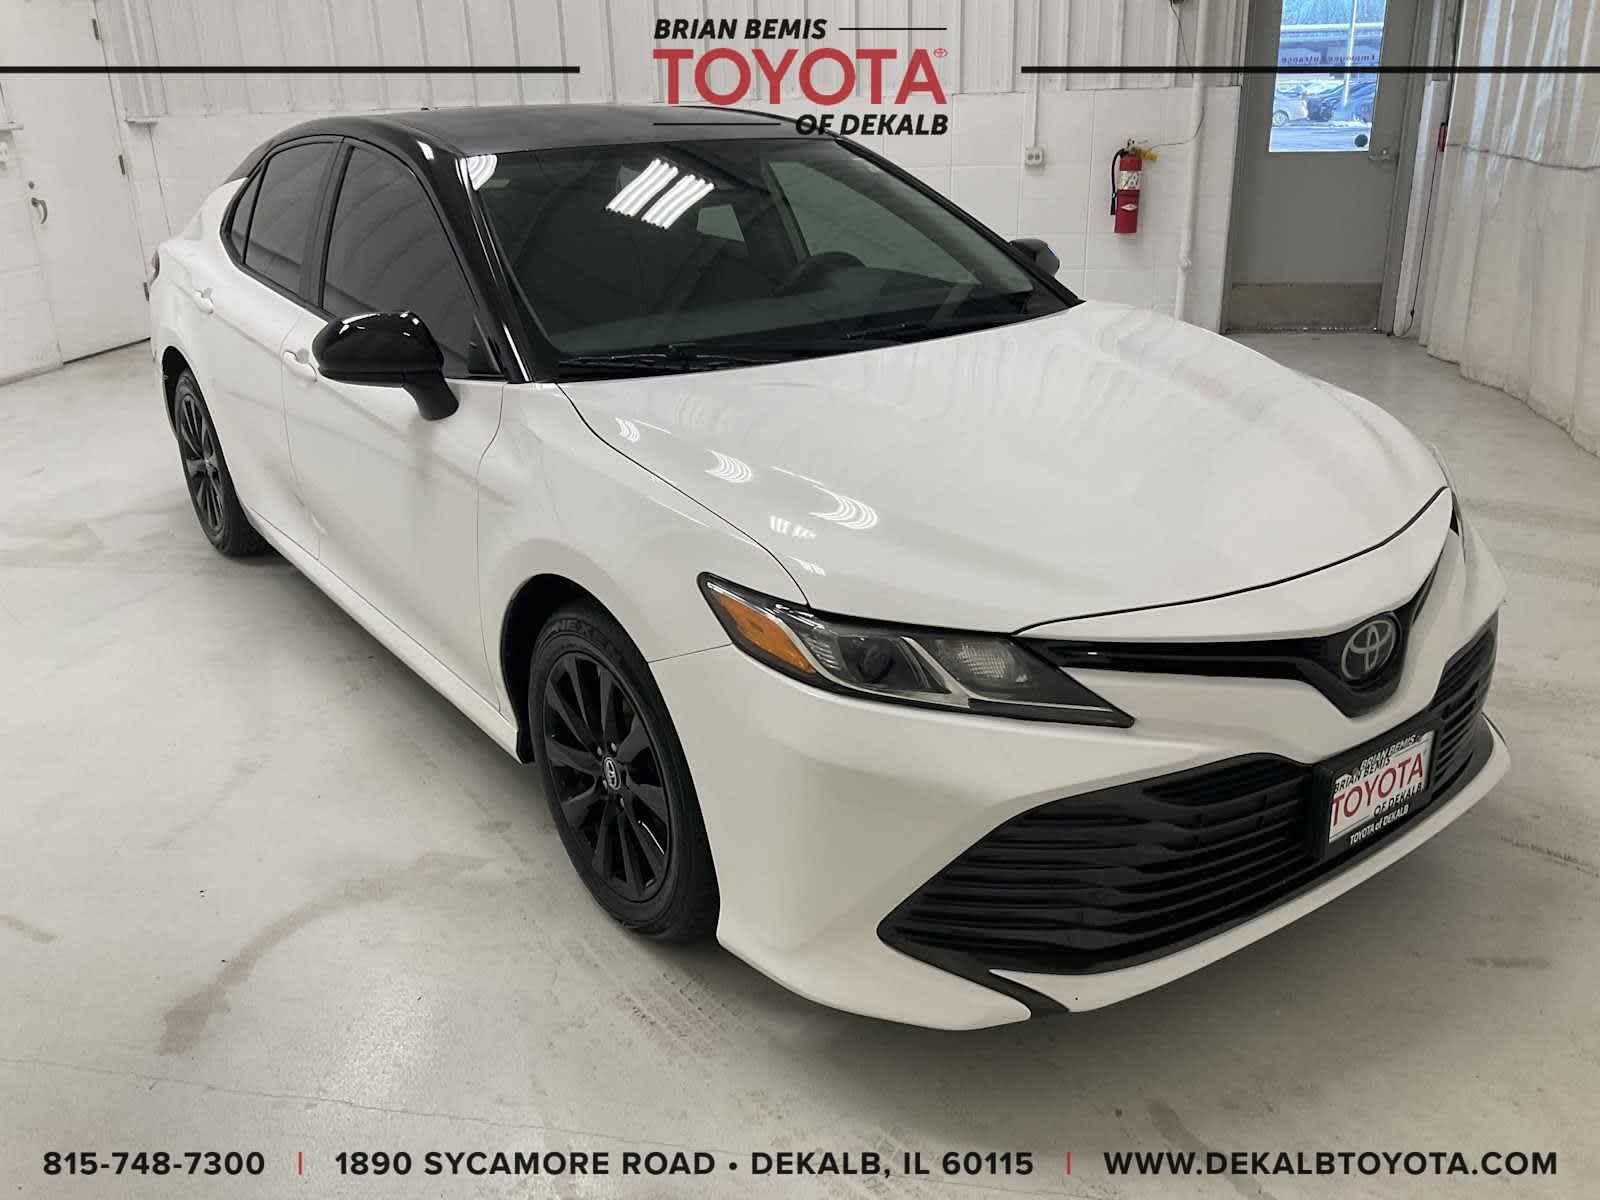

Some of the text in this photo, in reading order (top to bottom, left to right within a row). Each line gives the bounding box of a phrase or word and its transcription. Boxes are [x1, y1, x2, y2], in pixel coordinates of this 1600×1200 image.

[1332, 752, 1424, 827] TOYOTA
[1334, 771, 1362, 793] BRIAN
[1350, 825, 1375, 845] TOYOTA
[1383, 804, 1410, 827] DEKALB
[1373, 802, 1388, 818] OF
